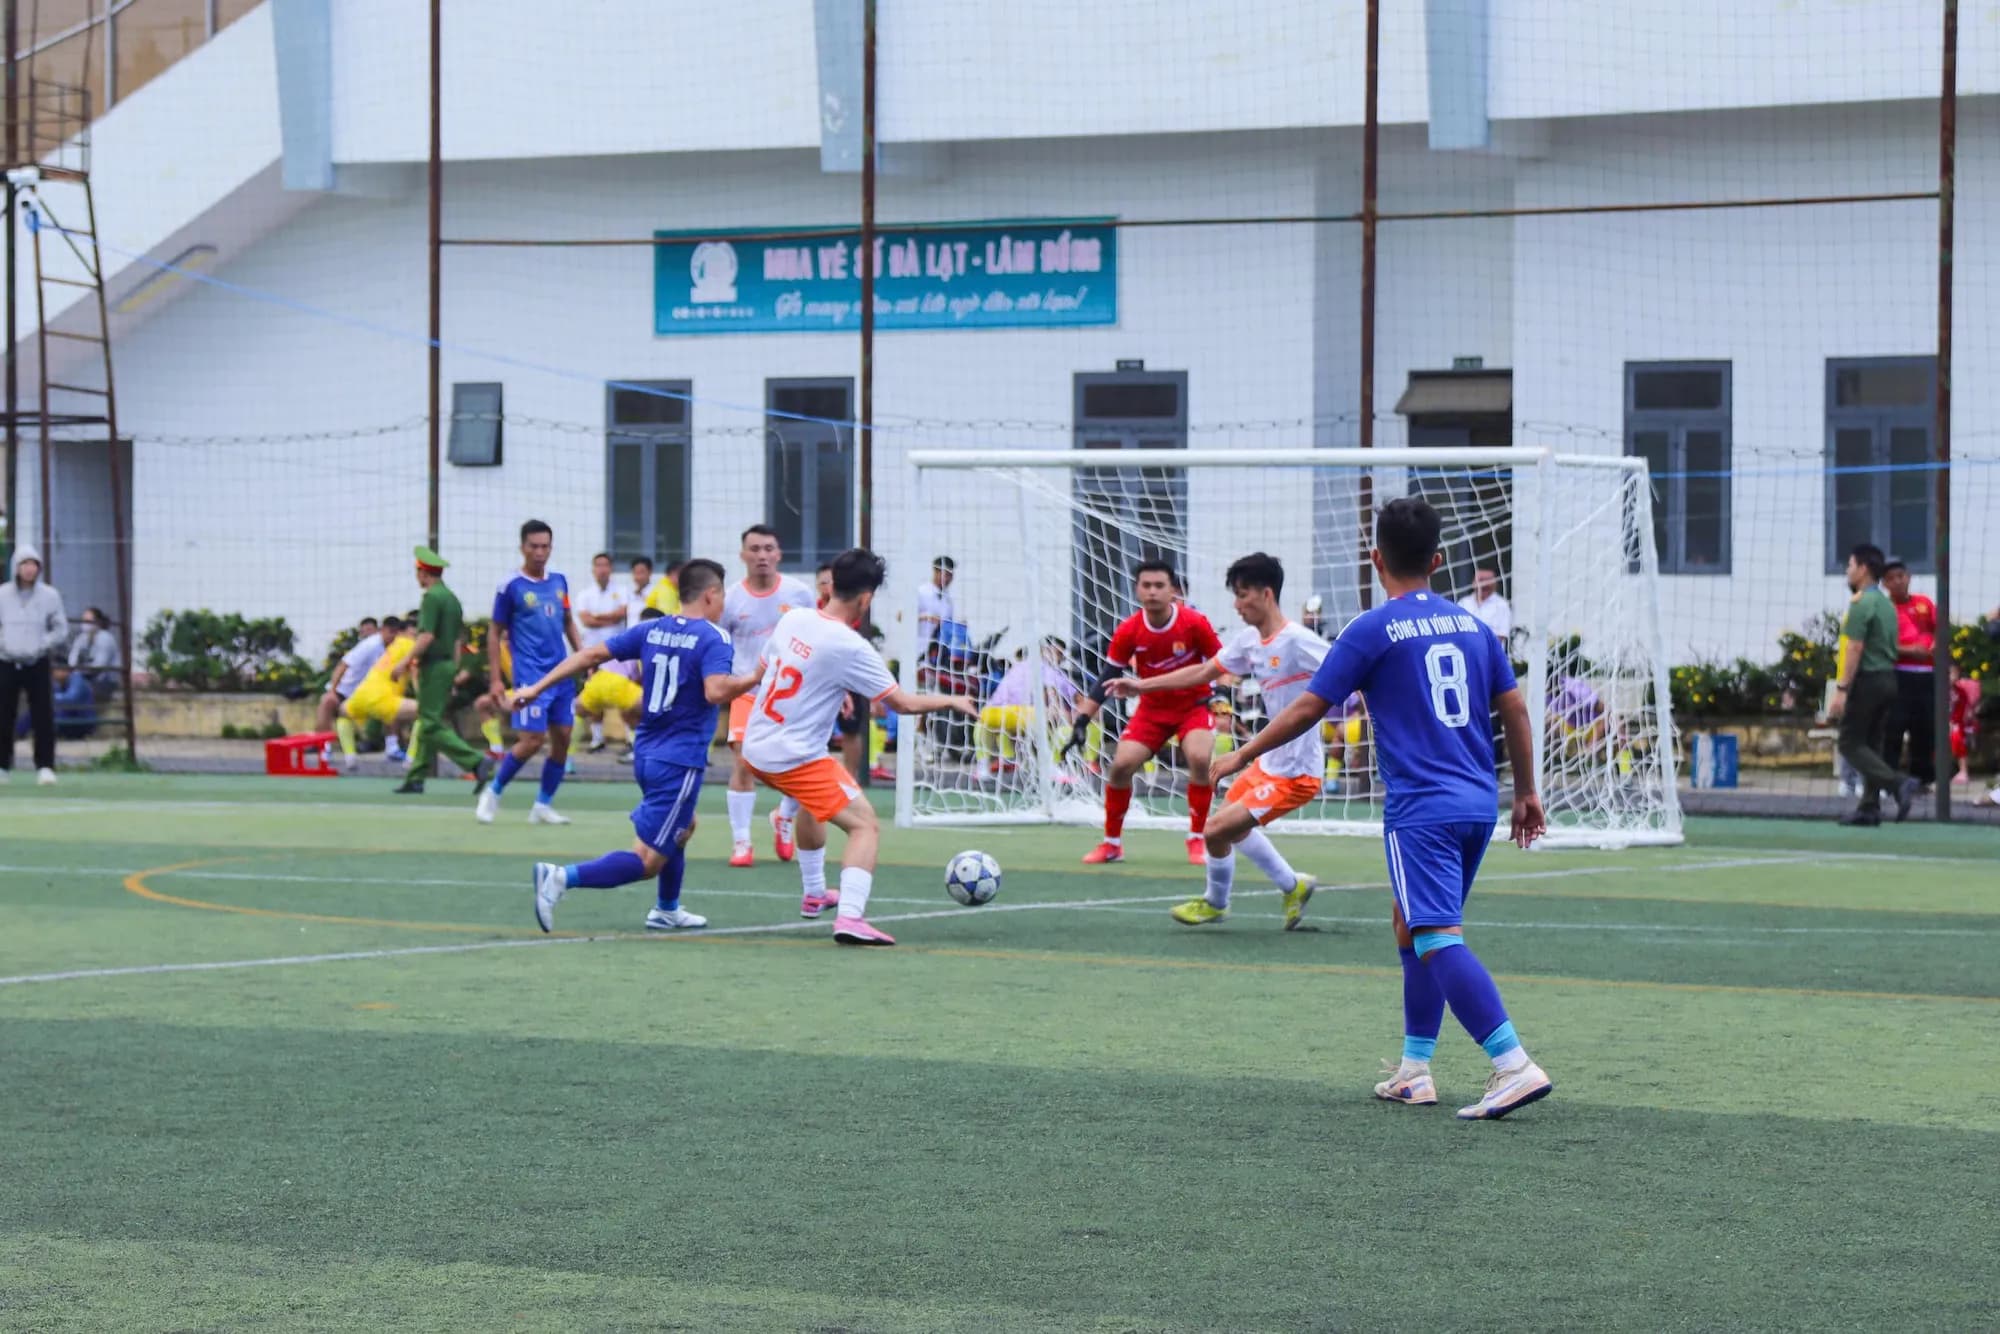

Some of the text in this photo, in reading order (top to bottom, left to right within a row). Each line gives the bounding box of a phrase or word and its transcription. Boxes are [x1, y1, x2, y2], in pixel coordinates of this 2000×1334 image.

[818, 240, 848, 280] VÉ
[889, 238, 921, 278] ĐÀ
[926, 243, 968, 282] LẠT
[985, 235, 1035, 275] LÂM
[1386, 618, 1418, 642] CÔNG
[1416, 618, 1432, 636] AN
[648, 653, 680, 713] 11
[760, 657, 803, 724] 12
[1425, 643, 1470, 727] 8
